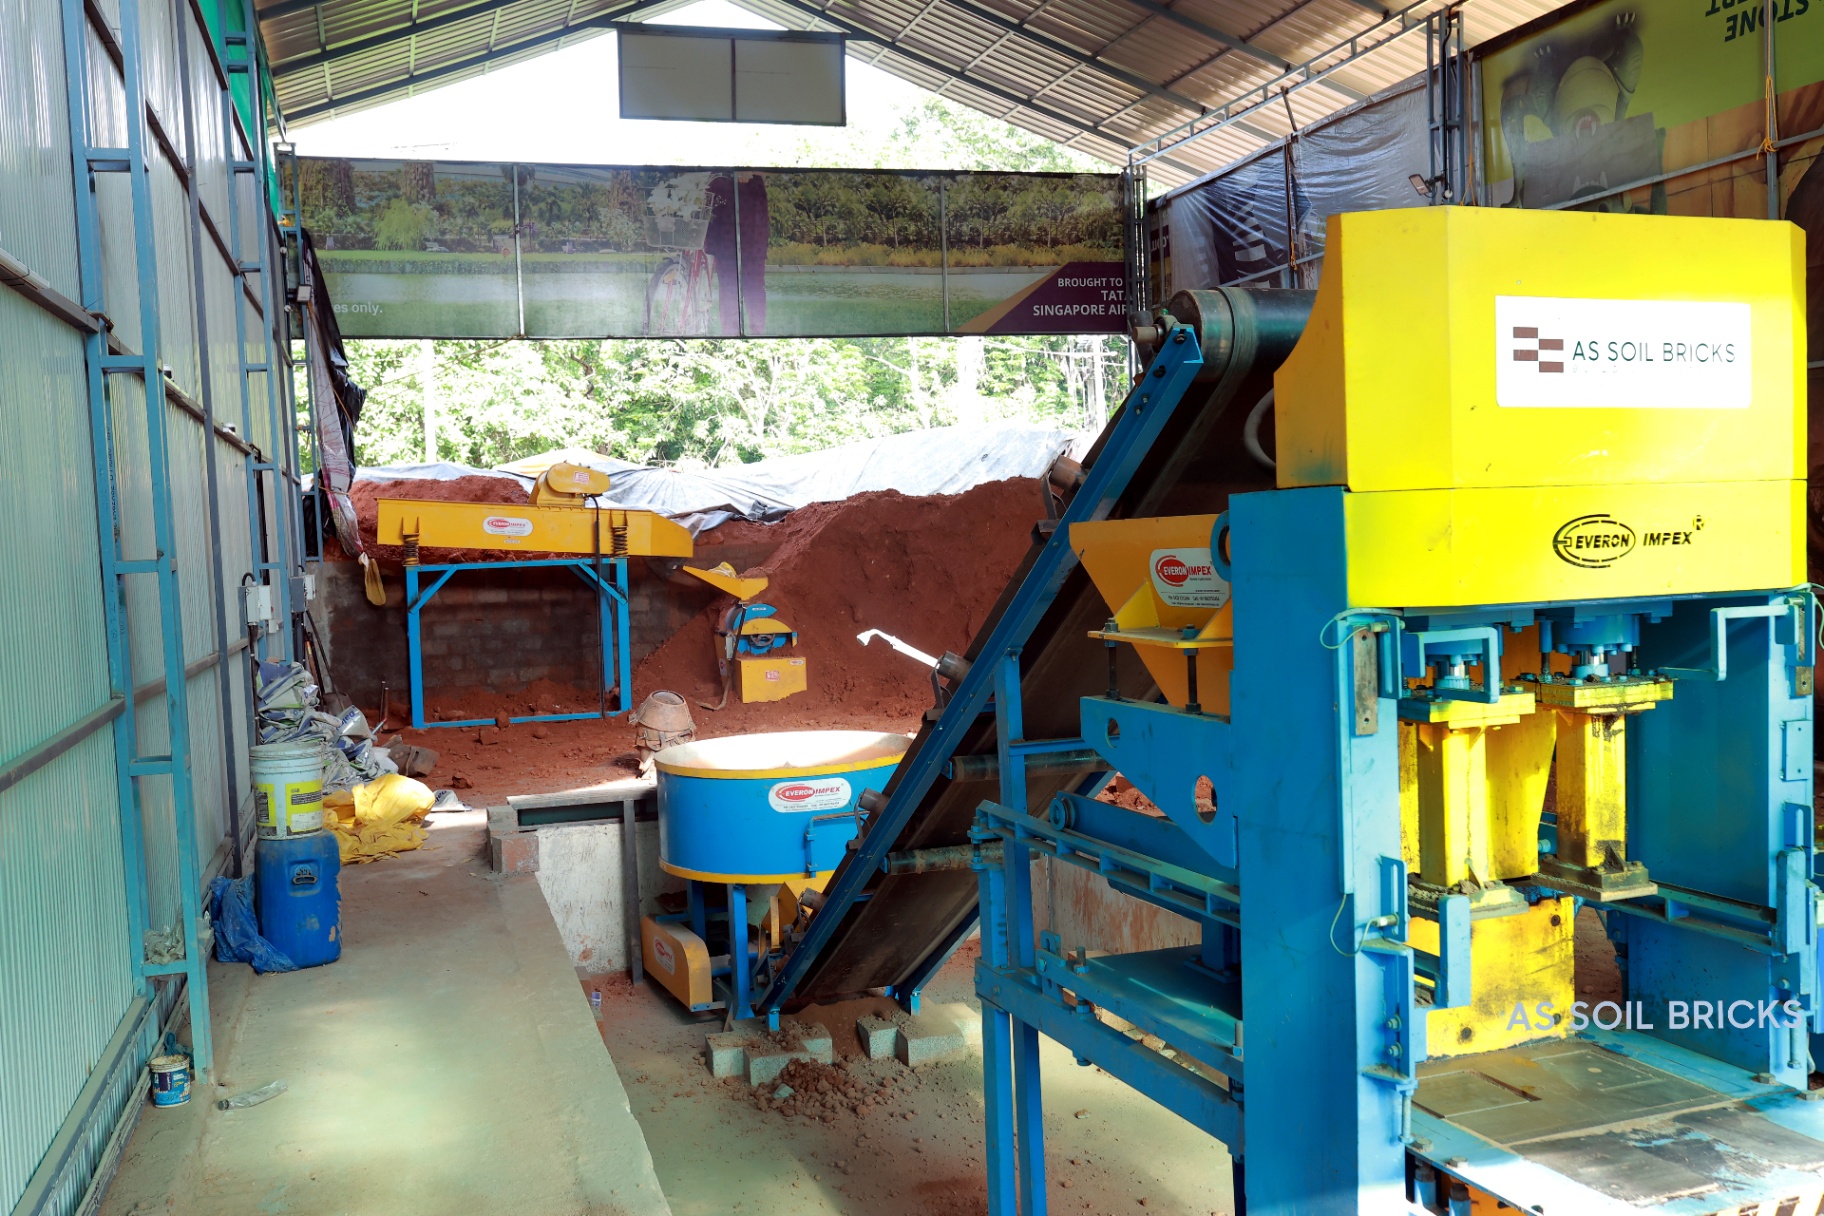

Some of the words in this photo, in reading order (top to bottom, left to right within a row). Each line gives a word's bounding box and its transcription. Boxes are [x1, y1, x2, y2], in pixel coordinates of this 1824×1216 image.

[1057, 277, 1107, 287] BROUGHT
[1109, 277, 1123, 287] TO
[332, 303, 349, 314] es
[351, 302, 383, 316] only.
[1033, 304, 1106, 316] SINGAPORE
[1572, 340, 1600, 361] AS
[1607, 341, 1654, 362] SOIL
[1662, 342, 1736, 363] BRICKS
[1575, 534, 1630, 549] EVERON
[1643, 531, 1693, 547] IMPEX
[1163, 565, 1188, 576] EVERON
[1188, 565, 1212, 576] IMPEX
[785, 788, 814, 797] EVERON
[815, 786, 841, 795] IMPEX
